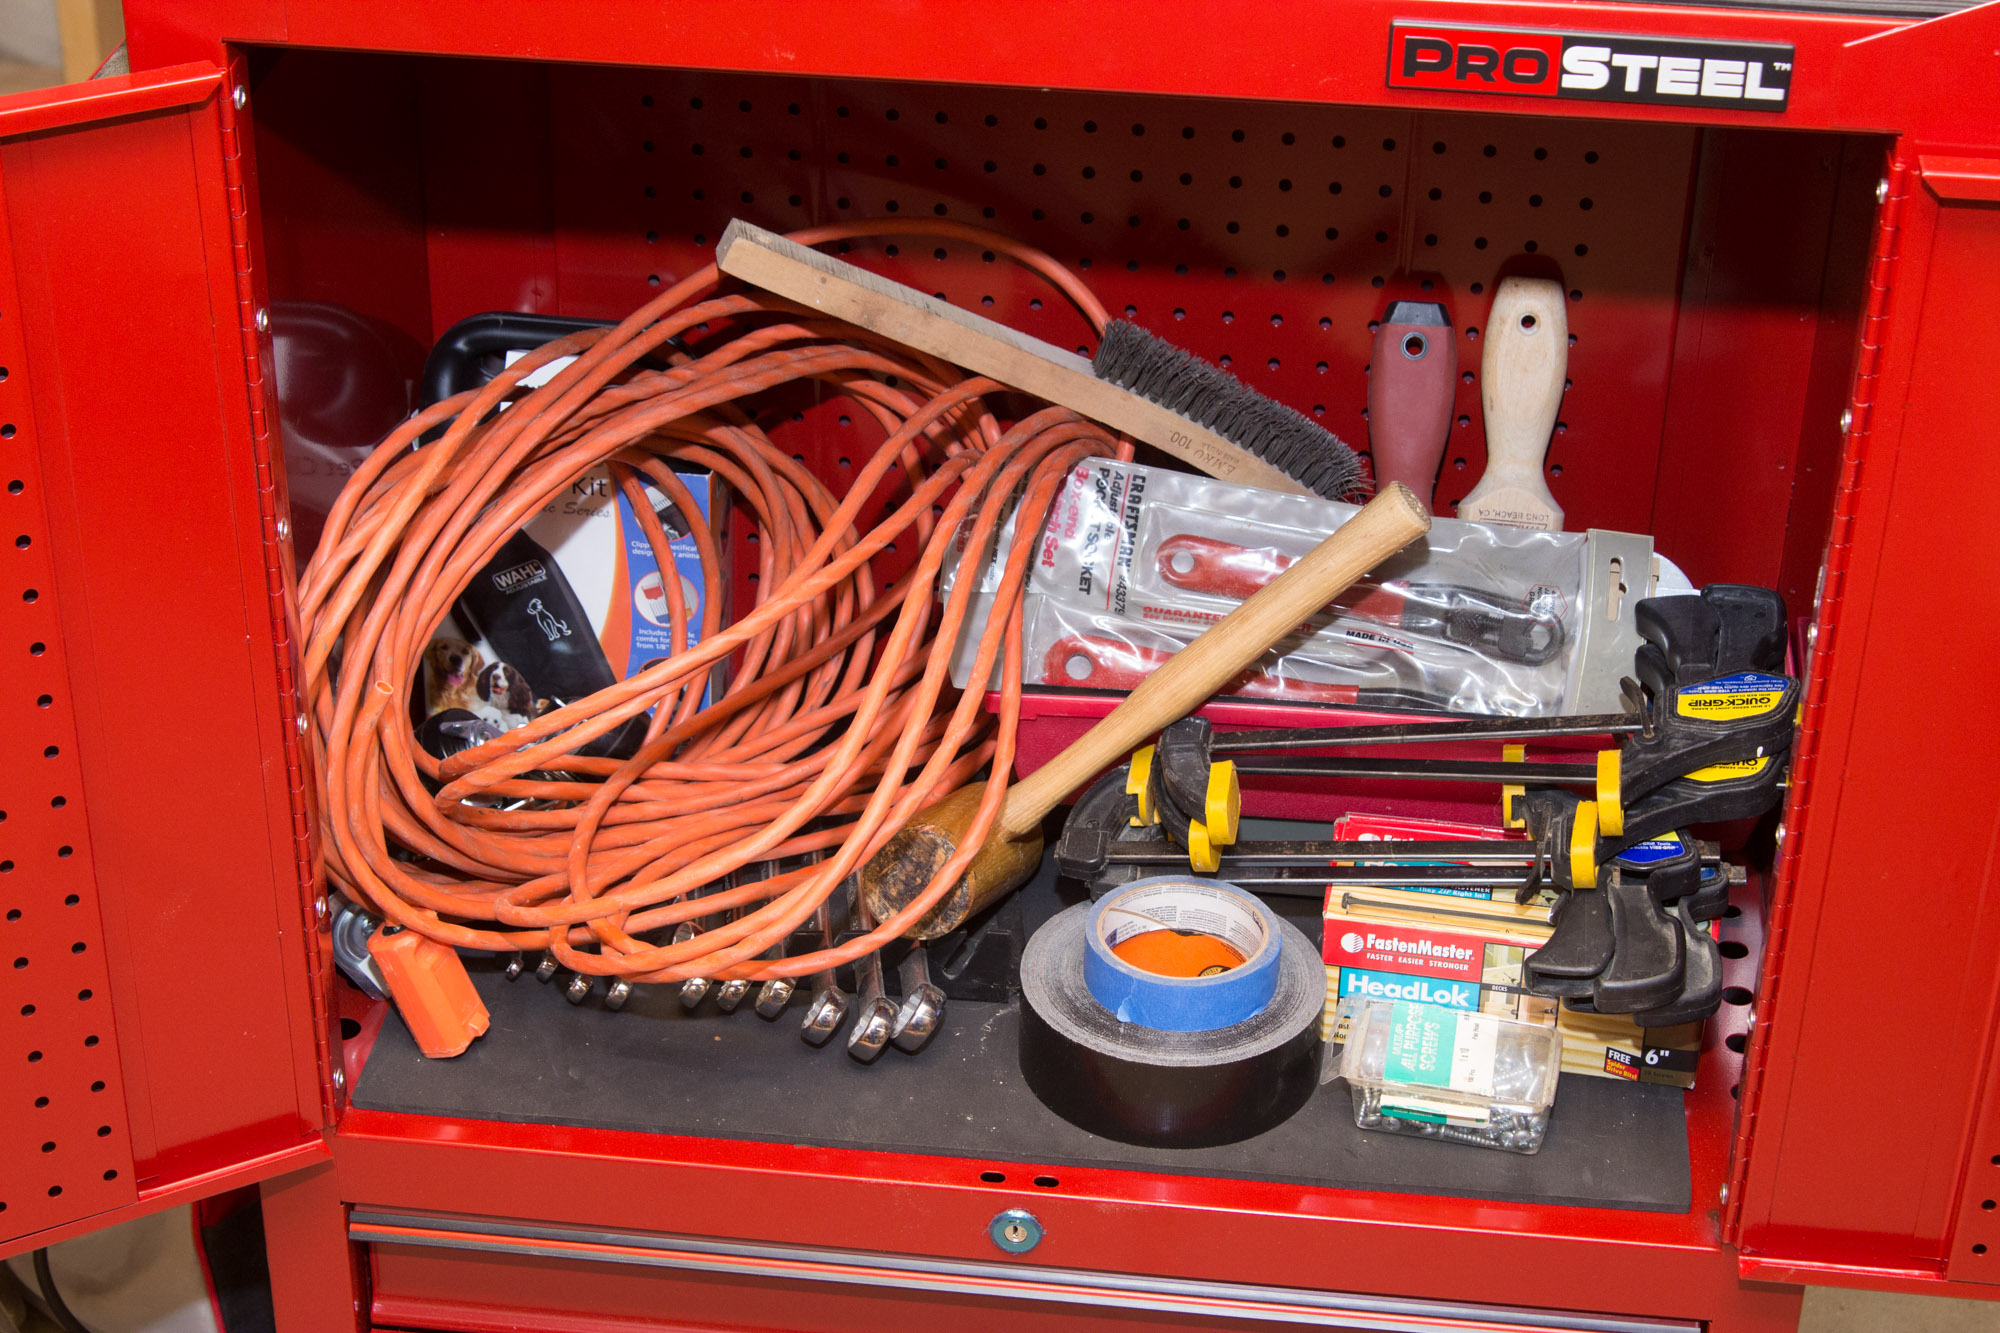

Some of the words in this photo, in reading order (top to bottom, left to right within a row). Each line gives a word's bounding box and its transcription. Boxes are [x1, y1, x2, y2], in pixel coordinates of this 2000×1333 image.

[572, 477, 607, 498] Kit
[1064, 466, 1090, 540] Box-end
[1094, 467, 1110, 528] POCKT
[563, 502, 611, 518] Series
[1102, 471, 1125, 541] Adjustble
[1478, 508, 1490, 516] CA
[1526, 513, 1550, 521] LONG
[1041, 535, 1059, 568] Set
[636, 634, 658, 643] combs
[639, 628, 667, 637] Includes
[1346, 630, 1376, 642] MADE
[636, 642, 653, 650] from
[1688, 697, 1771, 707] QUICK-GRIP
[1366, 933, 1472, 961] FastenMaster
[1366, 952, 1393, 963] FASTER
[1398, 956, 1424, 966] EASIER
[1429, 960, 1469, 971] STRONGER
[1347, 973, 1470, 1007] HeadLok
[1491, 984, 1508, 992] DECKS
[1400, 1048, 1417, 1072] ALL
[1607, 1059, 1626, 1071] Spider
[1608, 1049, 1632, 1065] FREE
[1645, 1049, 1670, 1065] 6"
[1606, 1066, 1623, 1075] Drive
